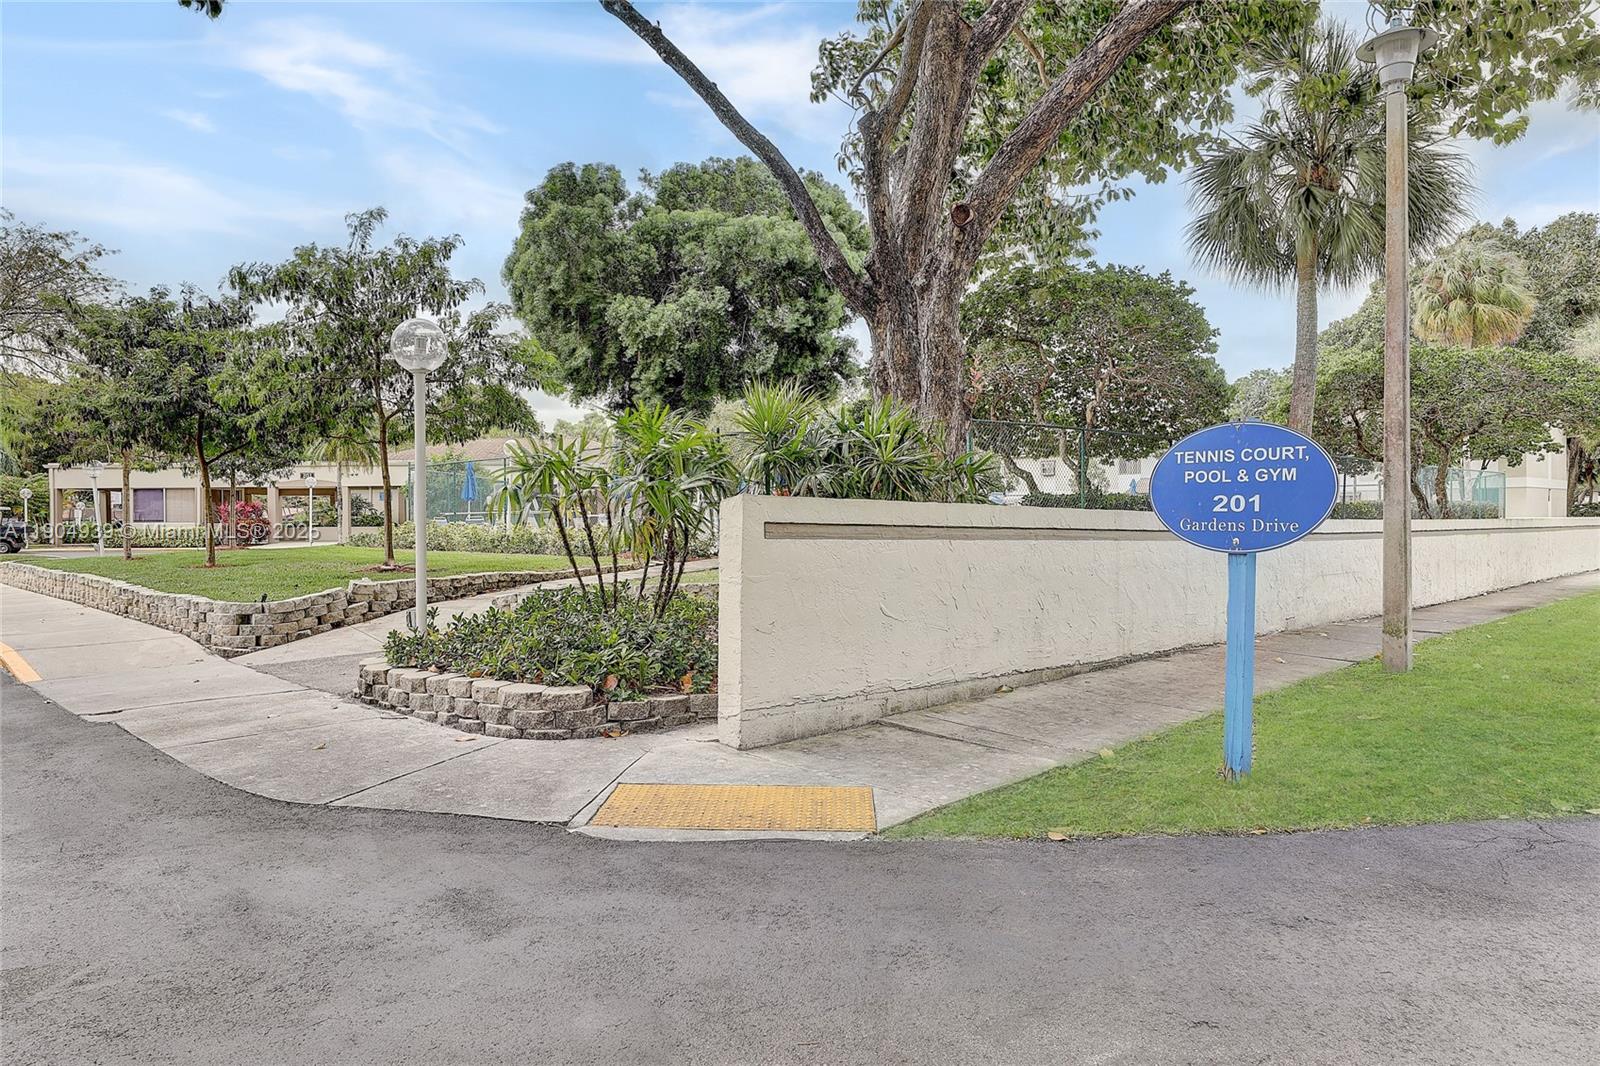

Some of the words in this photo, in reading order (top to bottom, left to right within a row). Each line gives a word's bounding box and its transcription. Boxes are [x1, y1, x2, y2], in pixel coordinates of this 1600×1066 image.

[1174, 449, 1235, 464] TENNIS
[1240, 445, 1310, 462] COURT,
[1184, 470, 1231, 483] POOL
[1237, 469, 1249, 482] &
[1255, 467, 1297, 481] GYM
[1212, 494, 1261, 512] 201
[1180, 518, 1246, 532] Gardens
[1252, 518, 1299, 533] Drive
